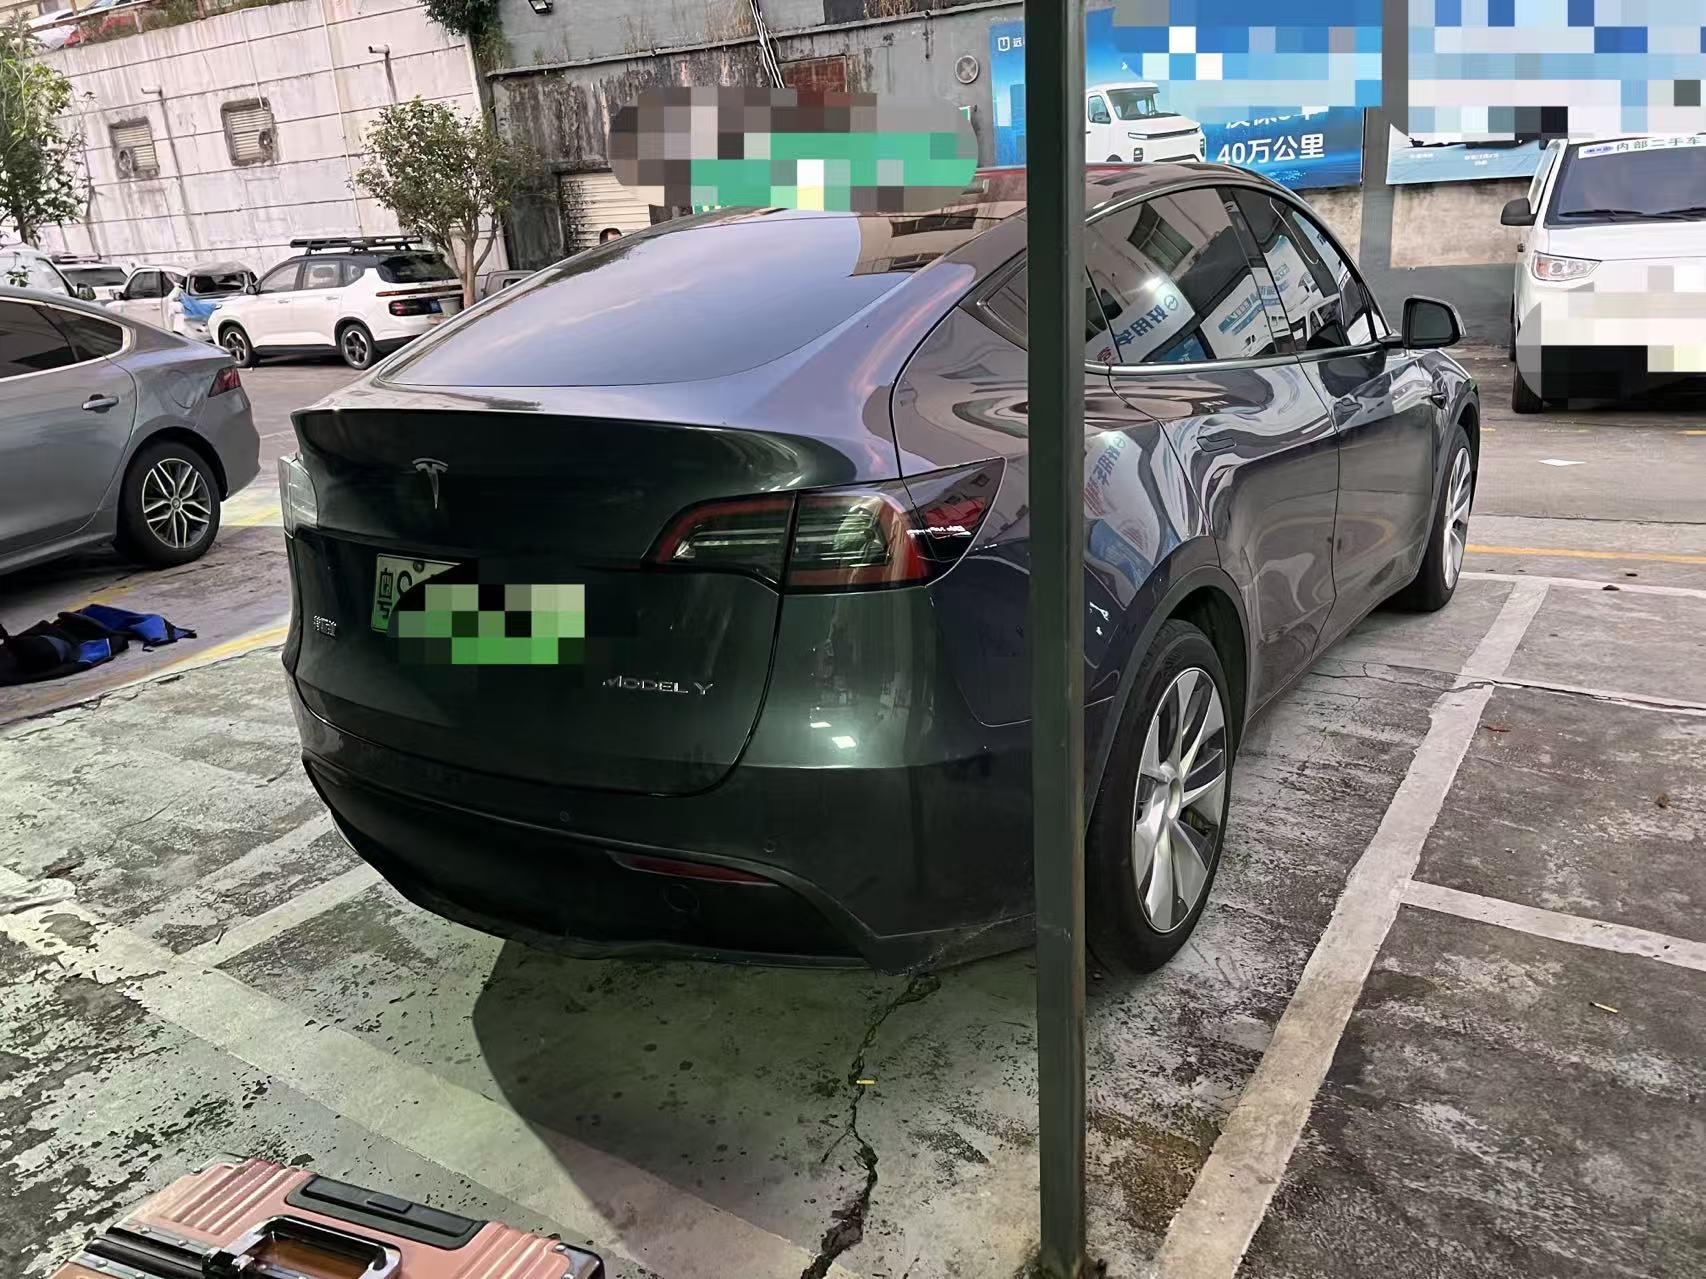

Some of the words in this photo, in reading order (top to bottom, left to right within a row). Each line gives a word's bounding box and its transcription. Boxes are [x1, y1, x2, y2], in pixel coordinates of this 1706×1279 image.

[1216, 133, 1325, 164] 40万公里
[1615, 136, 1703, 152] 内部二手车
[602, 675, 689, 694] MODEL
[692, 681, 714, 695] Y
